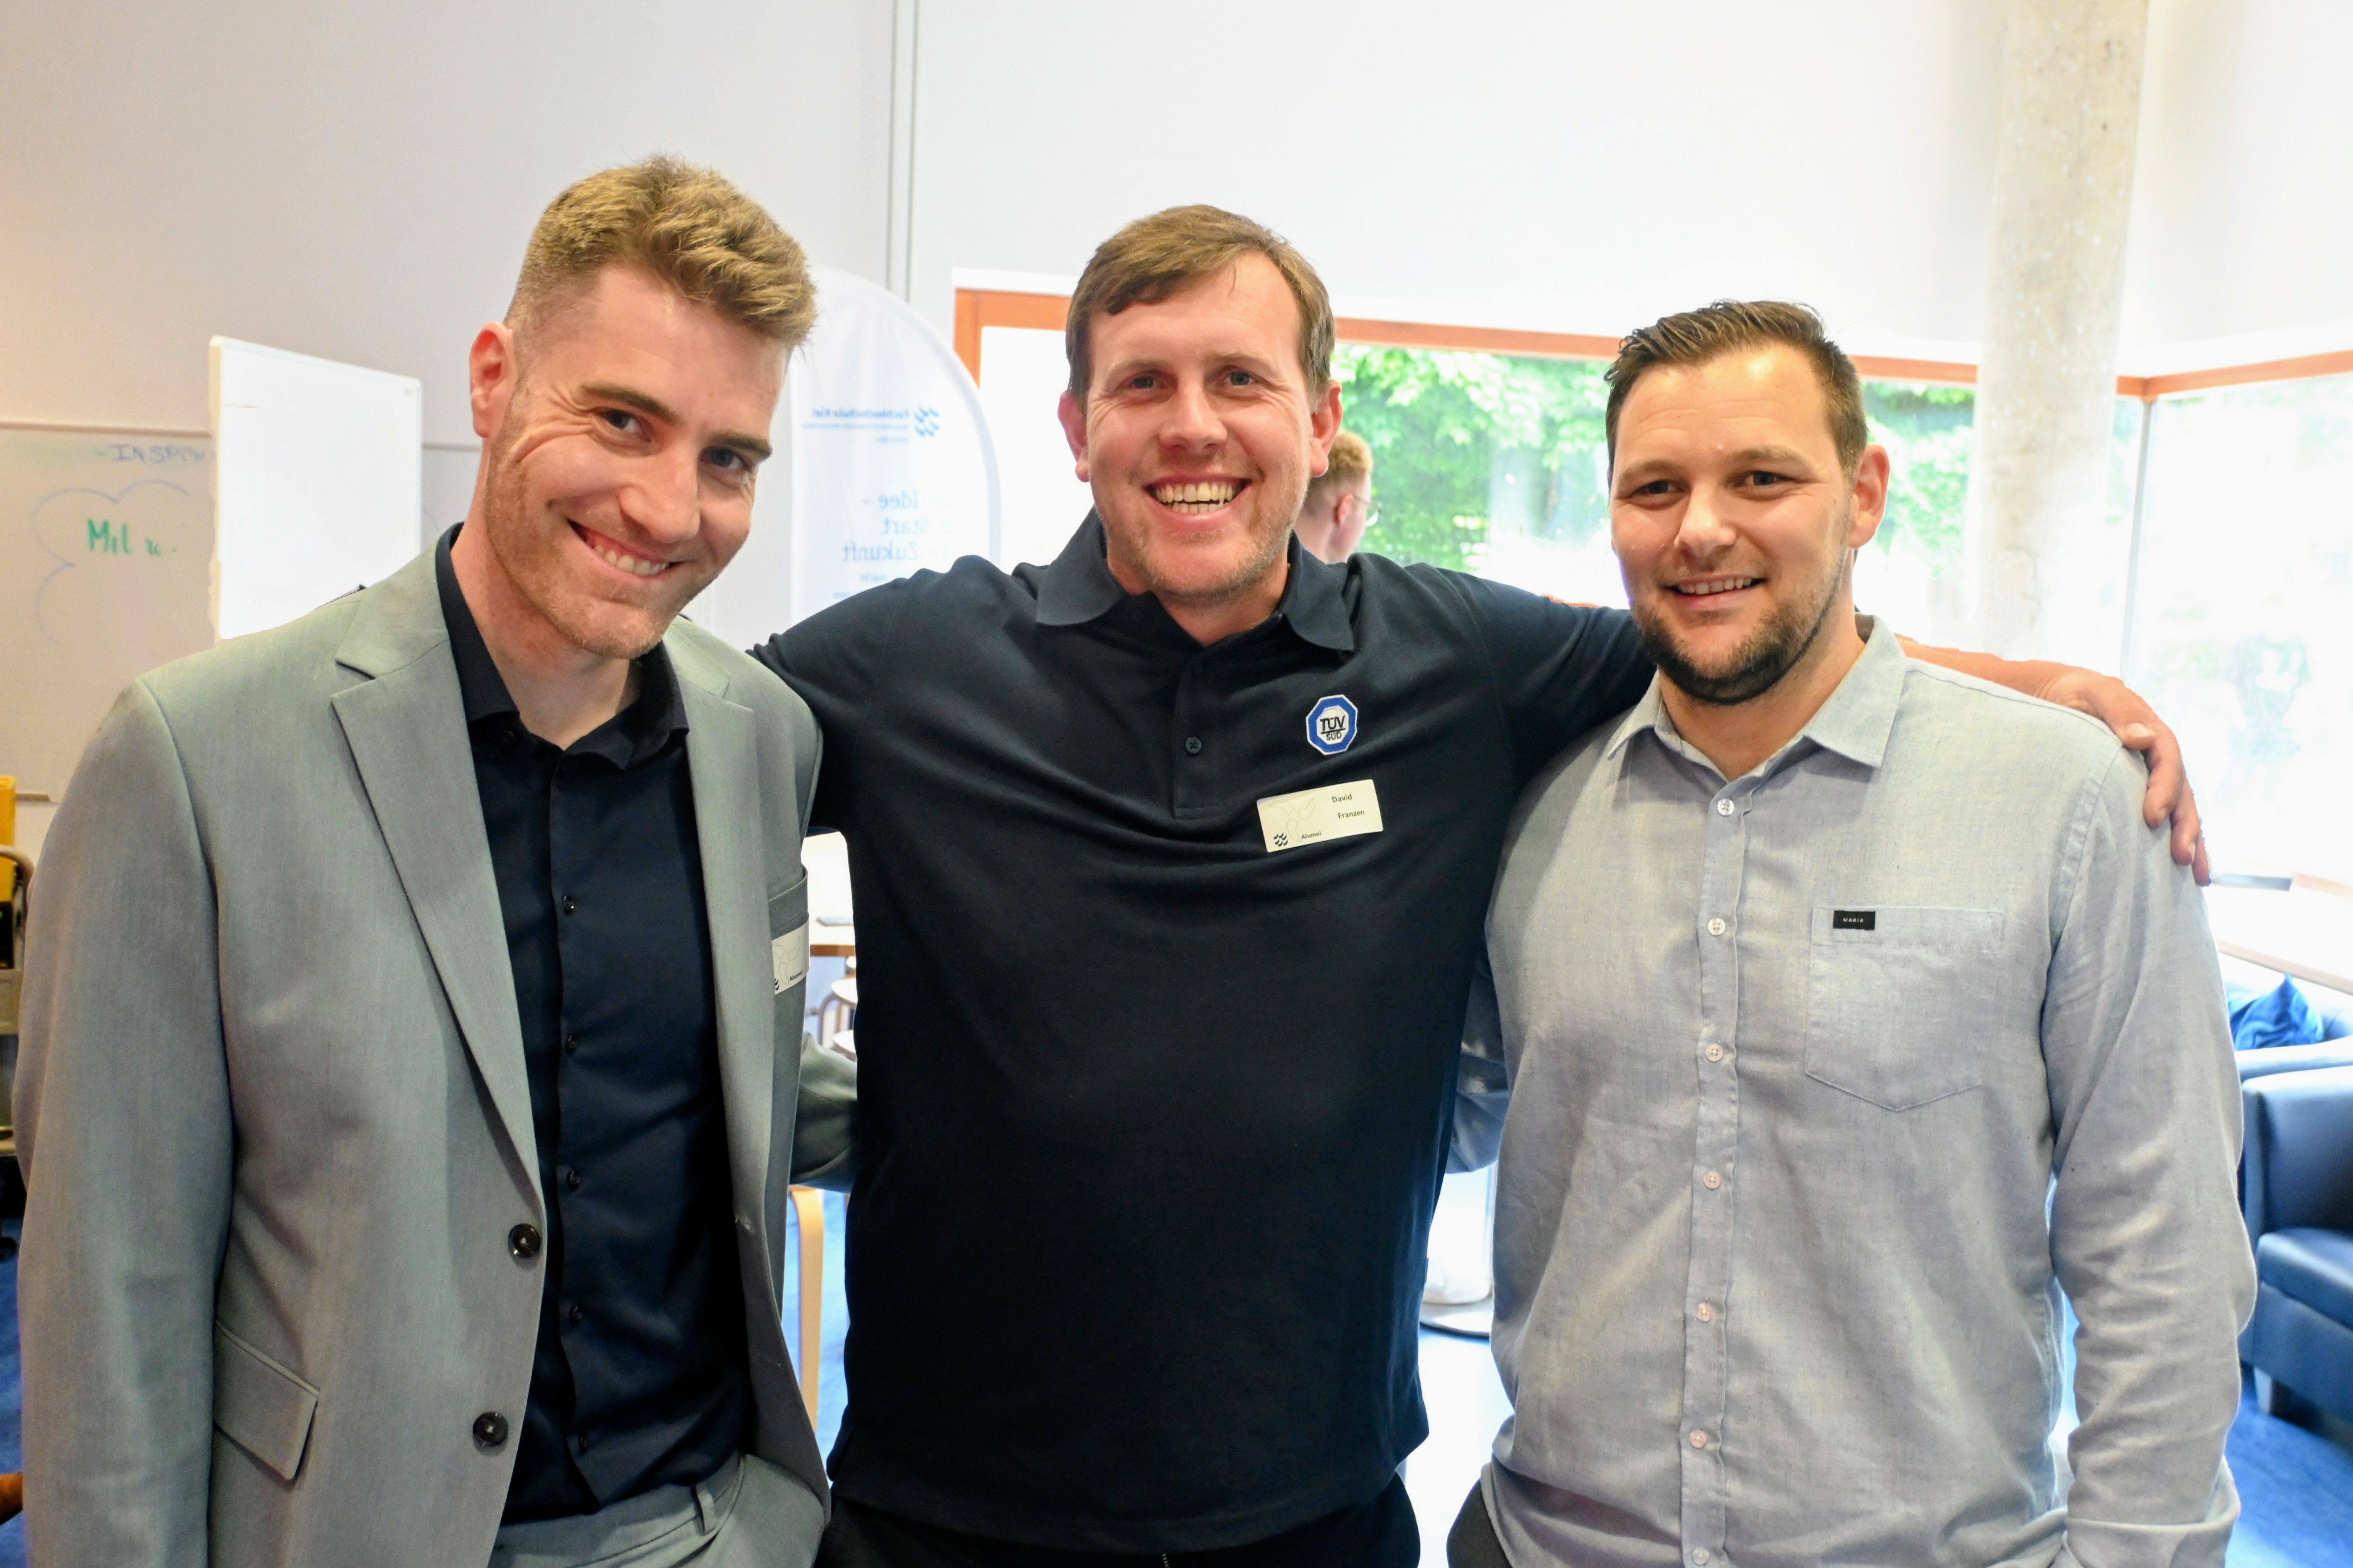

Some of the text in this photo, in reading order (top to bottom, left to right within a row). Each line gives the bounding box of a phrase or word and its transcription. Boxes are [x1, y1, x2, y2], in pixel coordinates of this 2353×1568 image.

[1320, 715, 1345, 731] TÜV
[1326, 731, 1342, 740] SÜD
[1332, 794, 1352, 802] David
[1338, 810, 1365, 819] Franzen
[1301, 831, 1322, 839] Alumni
